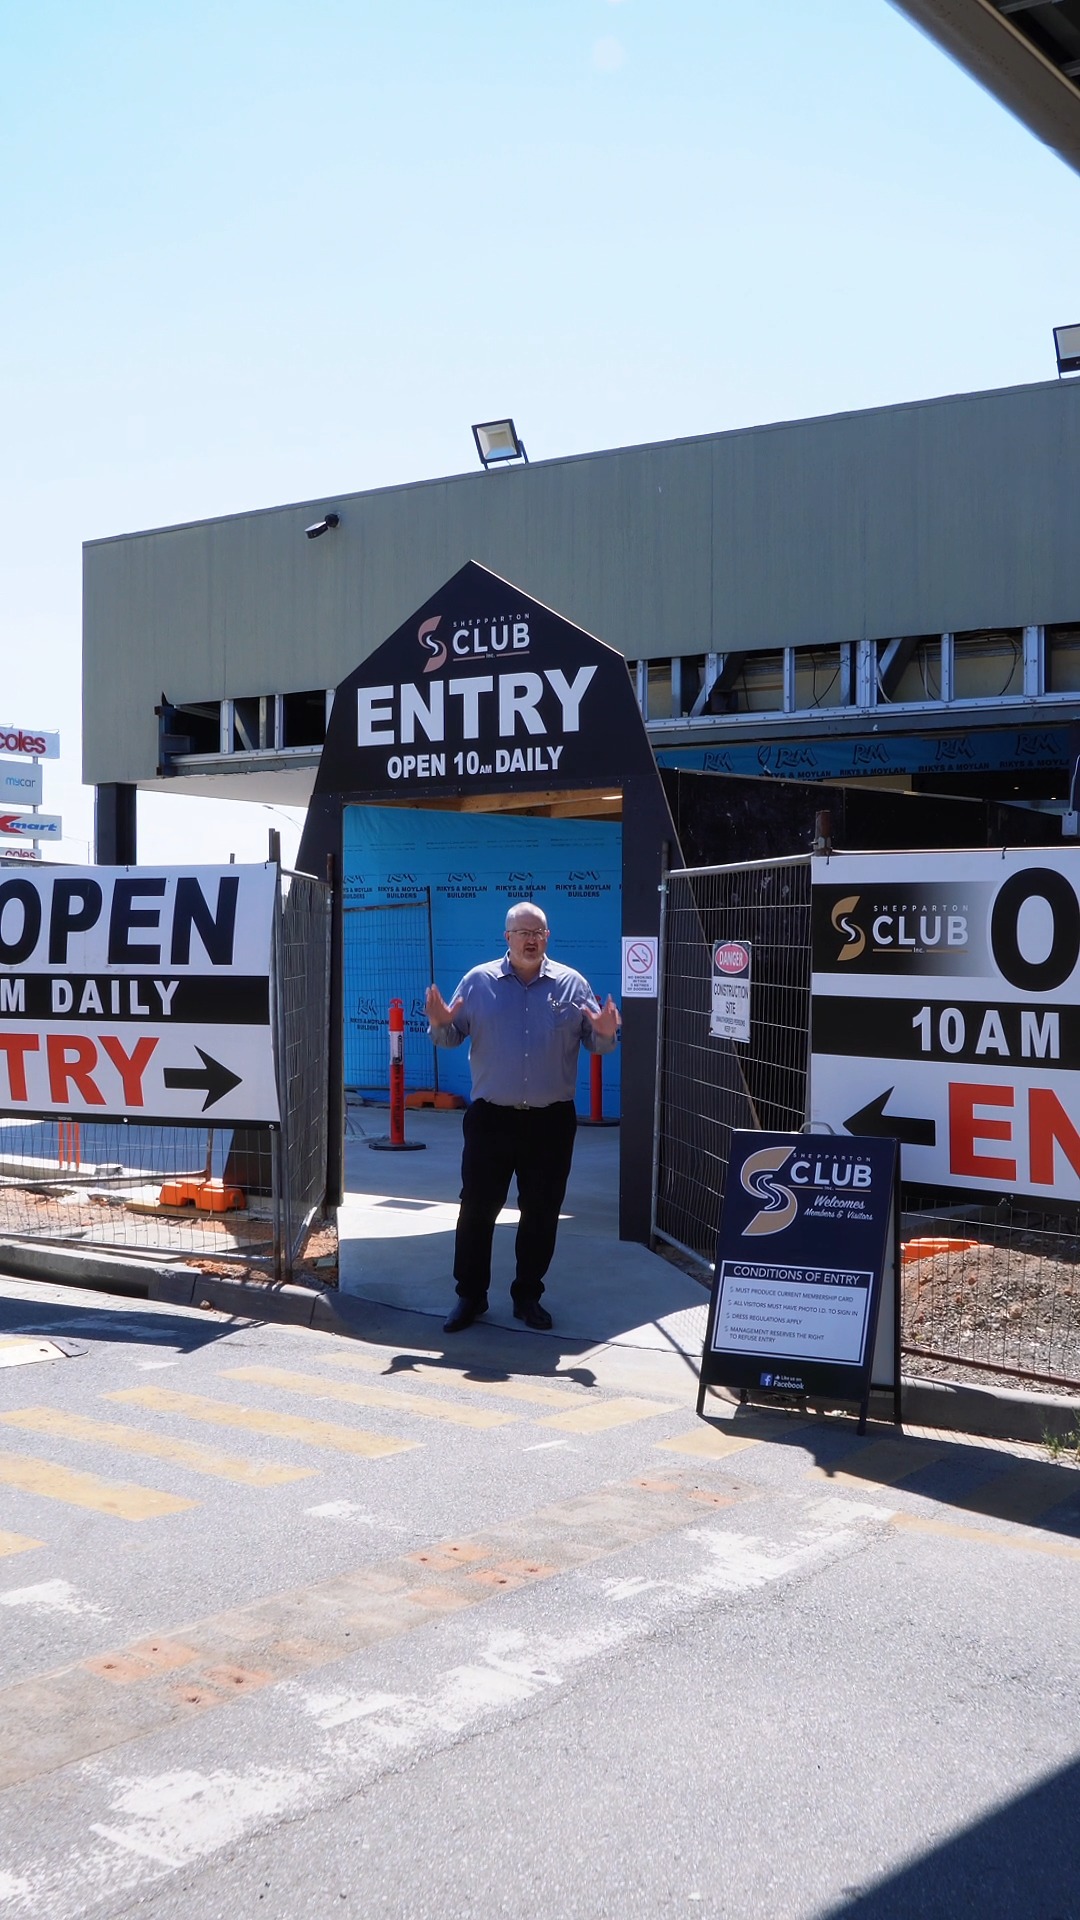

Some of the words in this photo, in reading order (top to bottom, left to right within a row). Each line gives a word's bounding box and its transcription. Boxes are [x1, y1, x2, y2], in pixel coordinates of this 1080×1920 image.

[453, 614, 530, 627] SHEPPARTON
[452, 622, 531, 655] CLUB
[357, 665, 598, 747] ENTRY
[387, 753, 446, 779] OPEN
[495, 746, 564, 774] DAILY
[956, 762, 990, 771] MOYLAN
[870, 766, 906, 775] MOYLAN
[5, 776, 36, 788] mycar
[873, 904, 968, 912] SHEPPARTON
[0, 877, 240, 966] OPEN
[872, 915, 969, 946] CLUB
[719, 951, 744, 967] DANGER
[52, 979, 180, 1016] DAILY
[714, 983, 749, 1000] CONSTRUCTION
[725, 1001, 736, 1015] SITE
[912, 1006, 1060, 1059] 10AM
[0, 1032, 160, 1108] TRY
[793, 1153, 871, 1162] SHEPPARTON
[790, 1161, 872, 1187] CLUB
[814, 1195, 866, 1209] Welcomes
[804, 1208, 835, 1218] Members
[836, 1210, 844, 1218] &
[847, 1211, 873, 1220] Visitors
[733, 1265, 803, 1281] CONDITIONS
[805, 1271, 821, 1282] OF
[823, 1273, 860, 1285] ENTRY
[751, 1288, 776, 1296] PRODUCE
[777, 1290, 801, 1298] CURRENT
[802, 1292, 838, 1300] MEMBERSHIP
[838, 1295, 854, 1303] CARD
[783, 1304, 798, 1312] HAVE
[749, 1314, 786, 1324] REGULATIONS
[786, 1317, 803, 1325] APPLY
[730, 1325, 769, 1335] MANAGEMENT
[769, 1329, 796, 1338] RESERVES
[808, 1333, 825, 1341] RIGHT
[773, 1380, 804, 1390] Facebook
